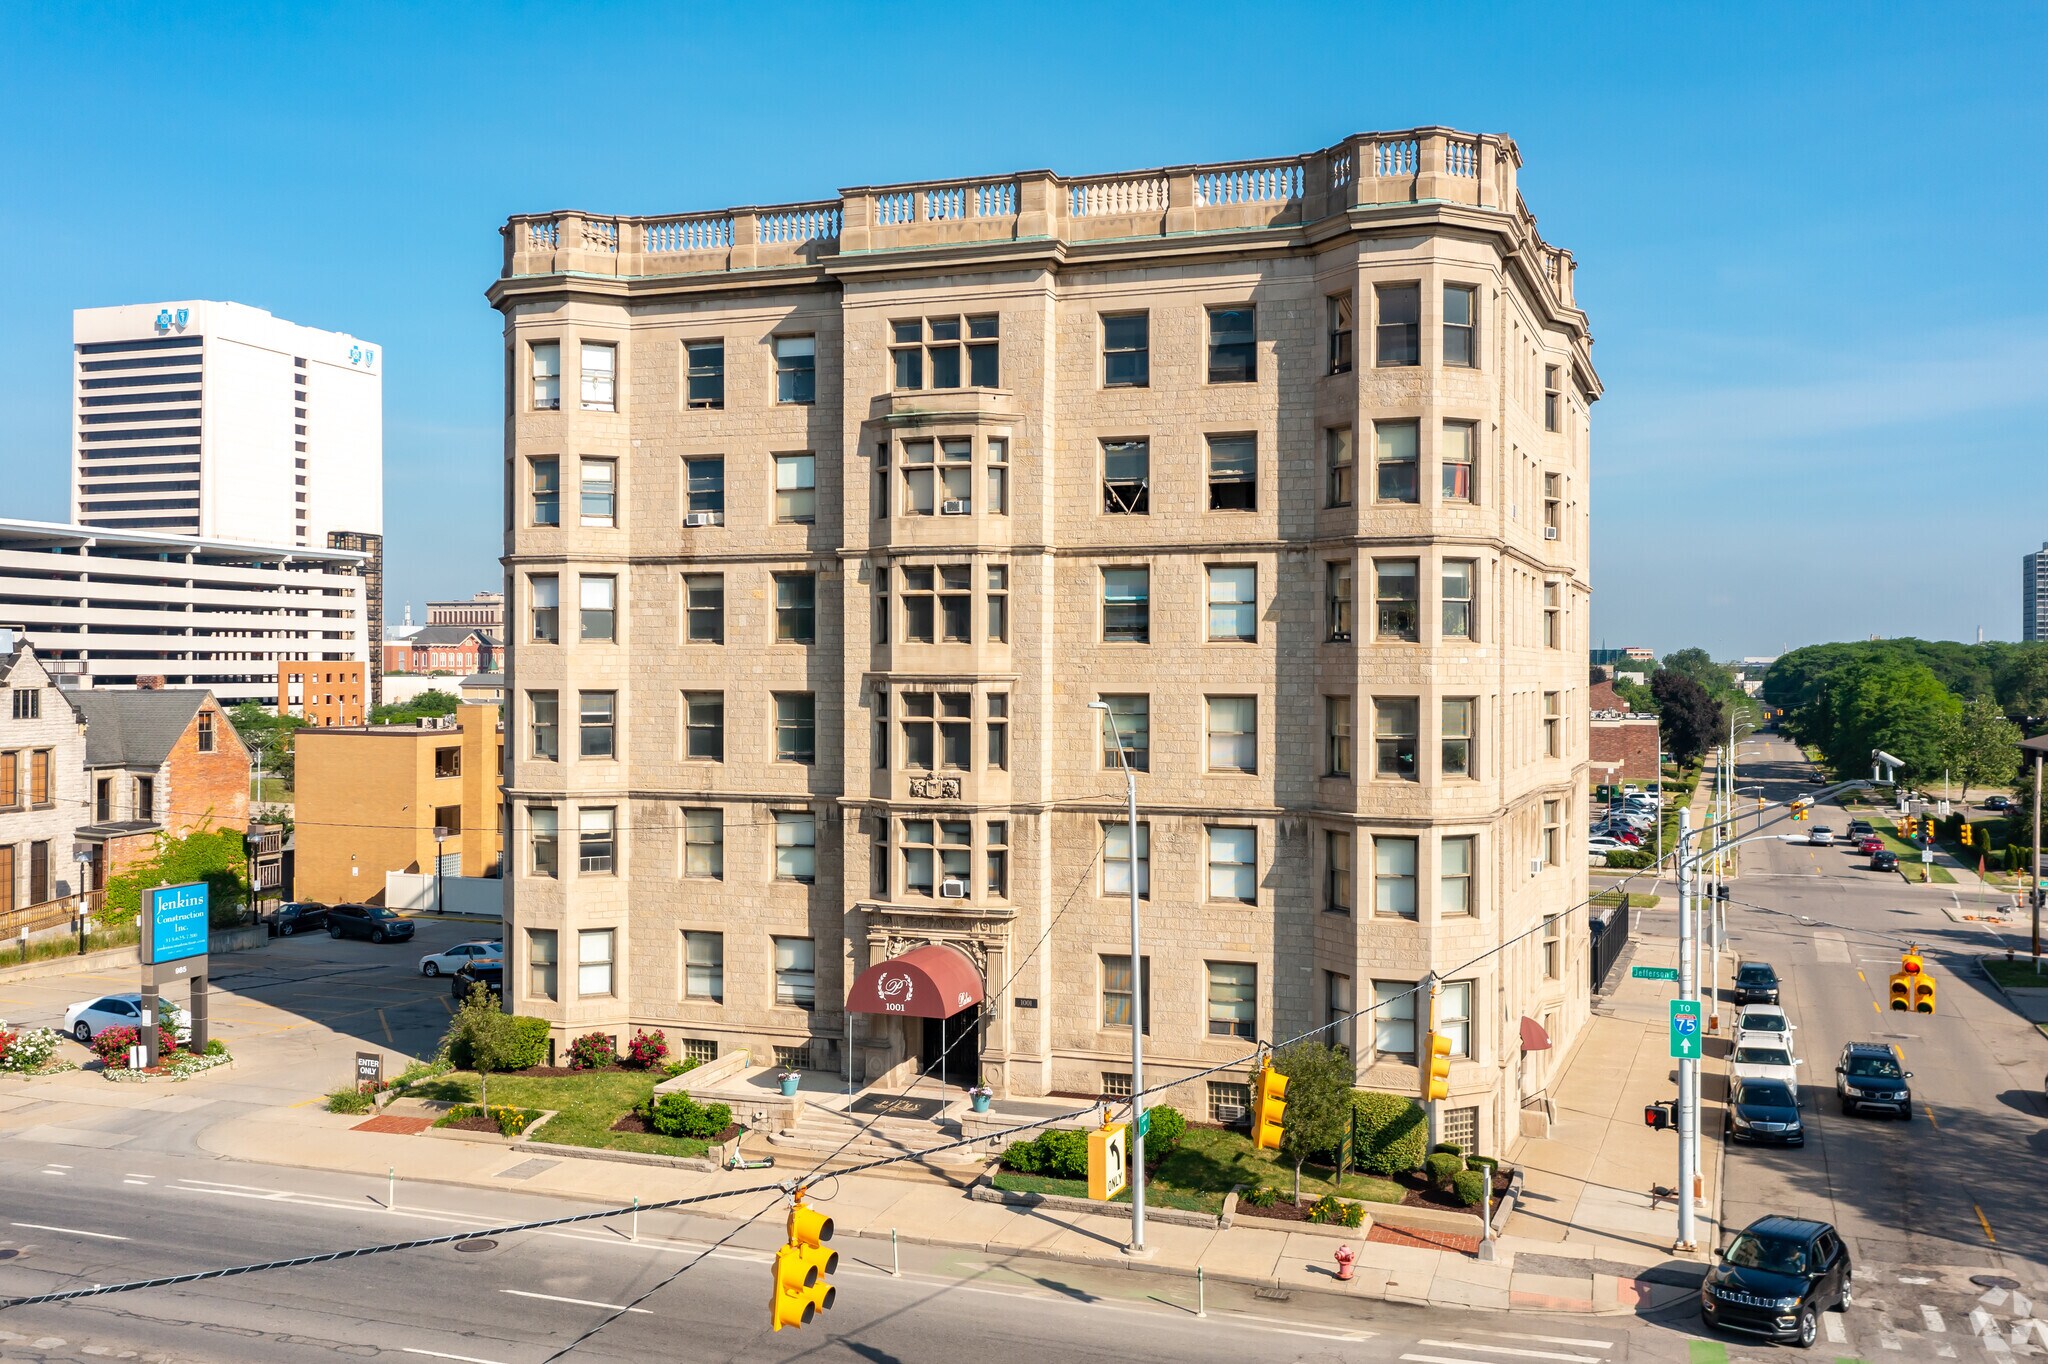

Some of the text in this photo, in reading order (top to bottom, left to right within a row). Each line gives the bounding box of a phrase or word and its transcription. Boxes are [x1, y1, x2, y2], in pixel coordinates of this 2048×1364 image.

[157, 891, 204, 915] Jenkins
[157, 911, 204, 924] Construction
[175, 924, 188, 932] Inc.
[175, 966, 187, 974] 985
[1634, 969, 1669, 978] Jefferson
[885, 1003, 905, 1011] 1001
[1676, 1019, 1695, 1031] 75
[358, 1058, 379, 1067] ENTER
[360, 1067, 377, 1075] ONLY
[1107, 1172, 1123, 1192] ONLY
